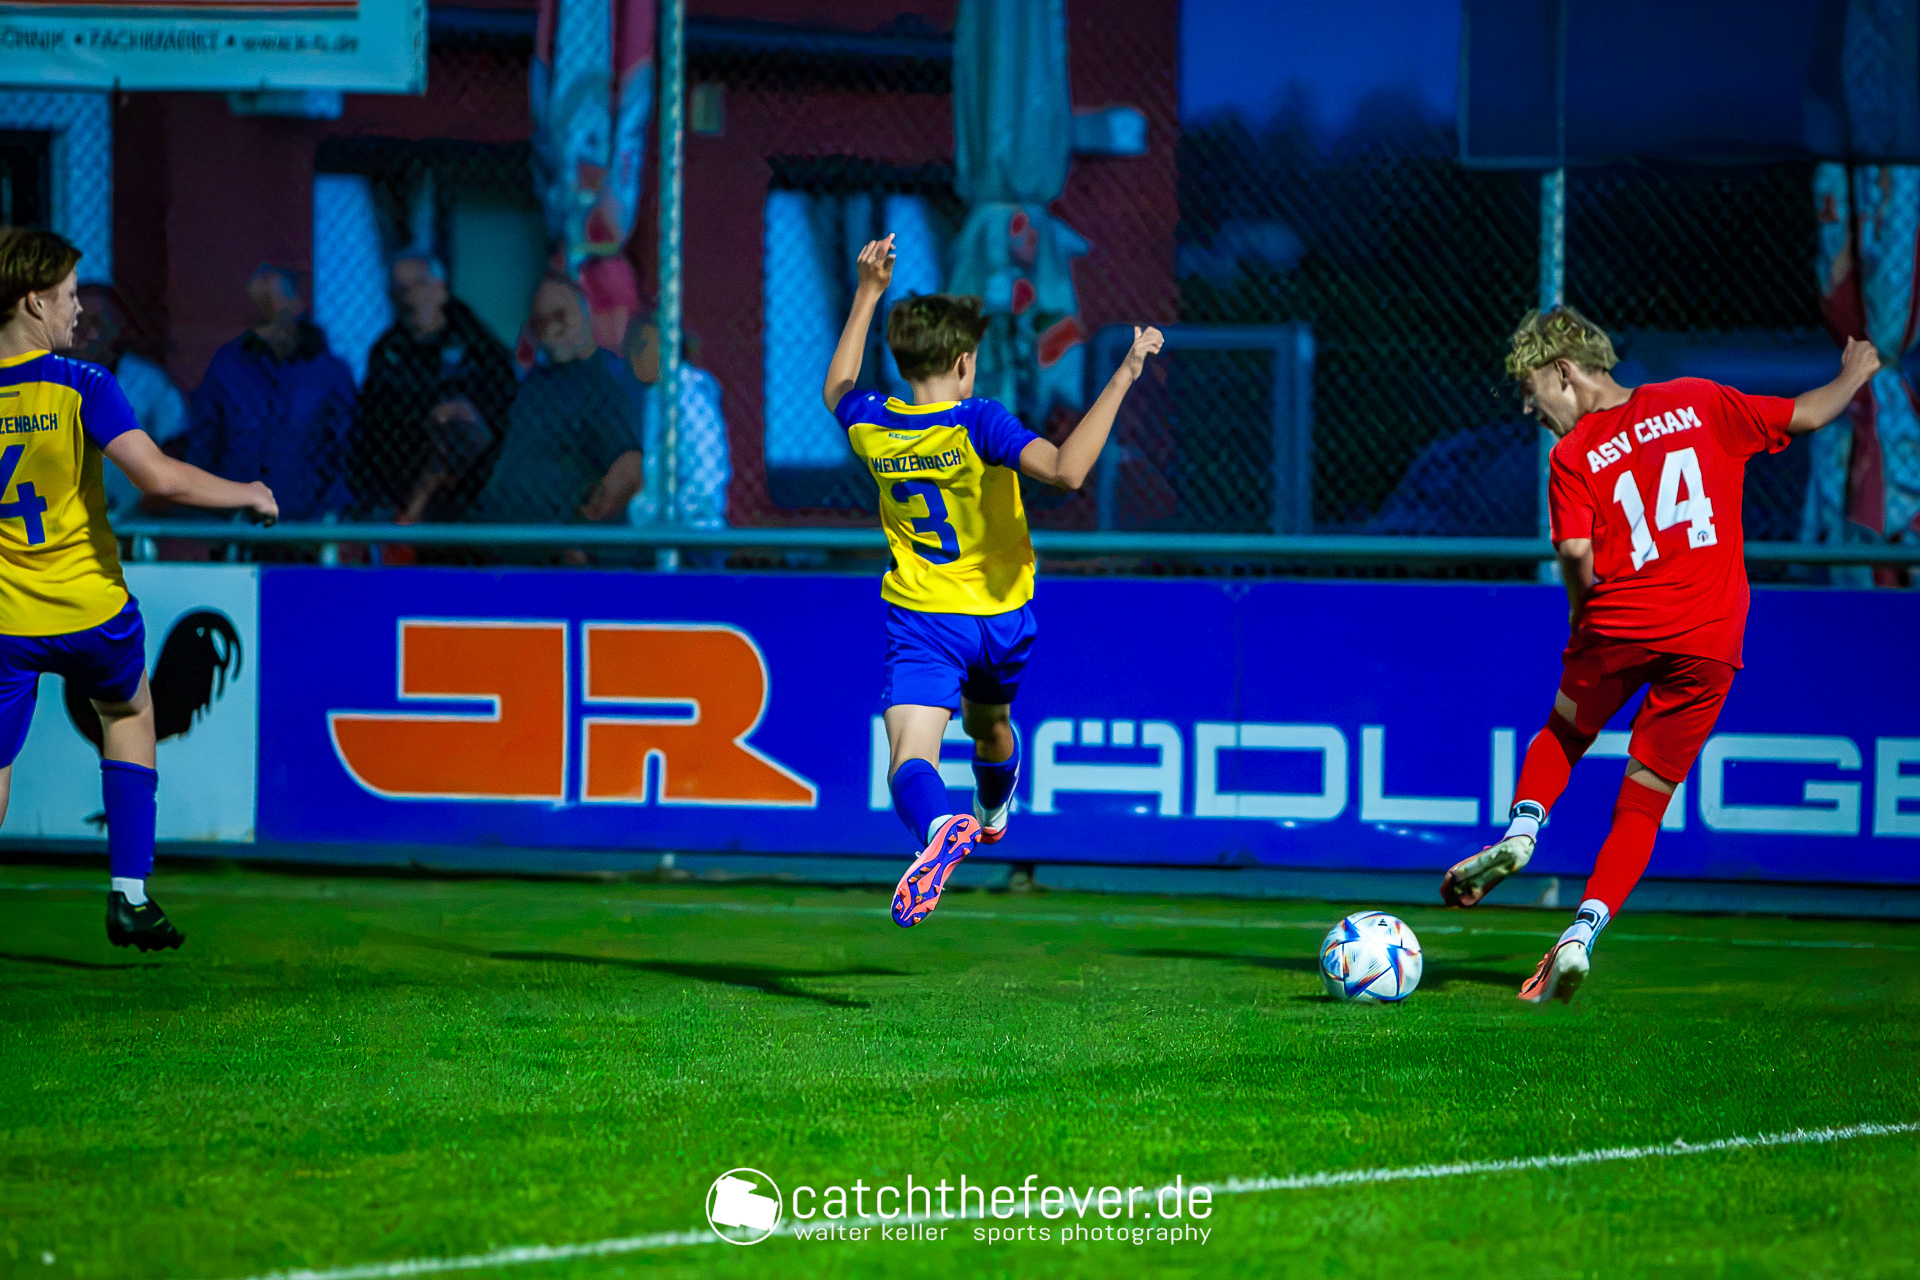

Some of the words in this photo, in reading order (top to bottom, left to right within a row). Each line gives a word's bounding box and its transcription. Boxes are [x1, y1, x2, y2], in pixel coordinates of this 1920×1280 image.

[871, 447, 962, 474] WENZENBACH
[1586, 431, 1633, 474] ASV
[1634, 406, 1702, 444] CHAM
[0, 444, 48, 546] 4
[890, 479, 961, 566] 3
[1613, 447, 1718, 572] 14
